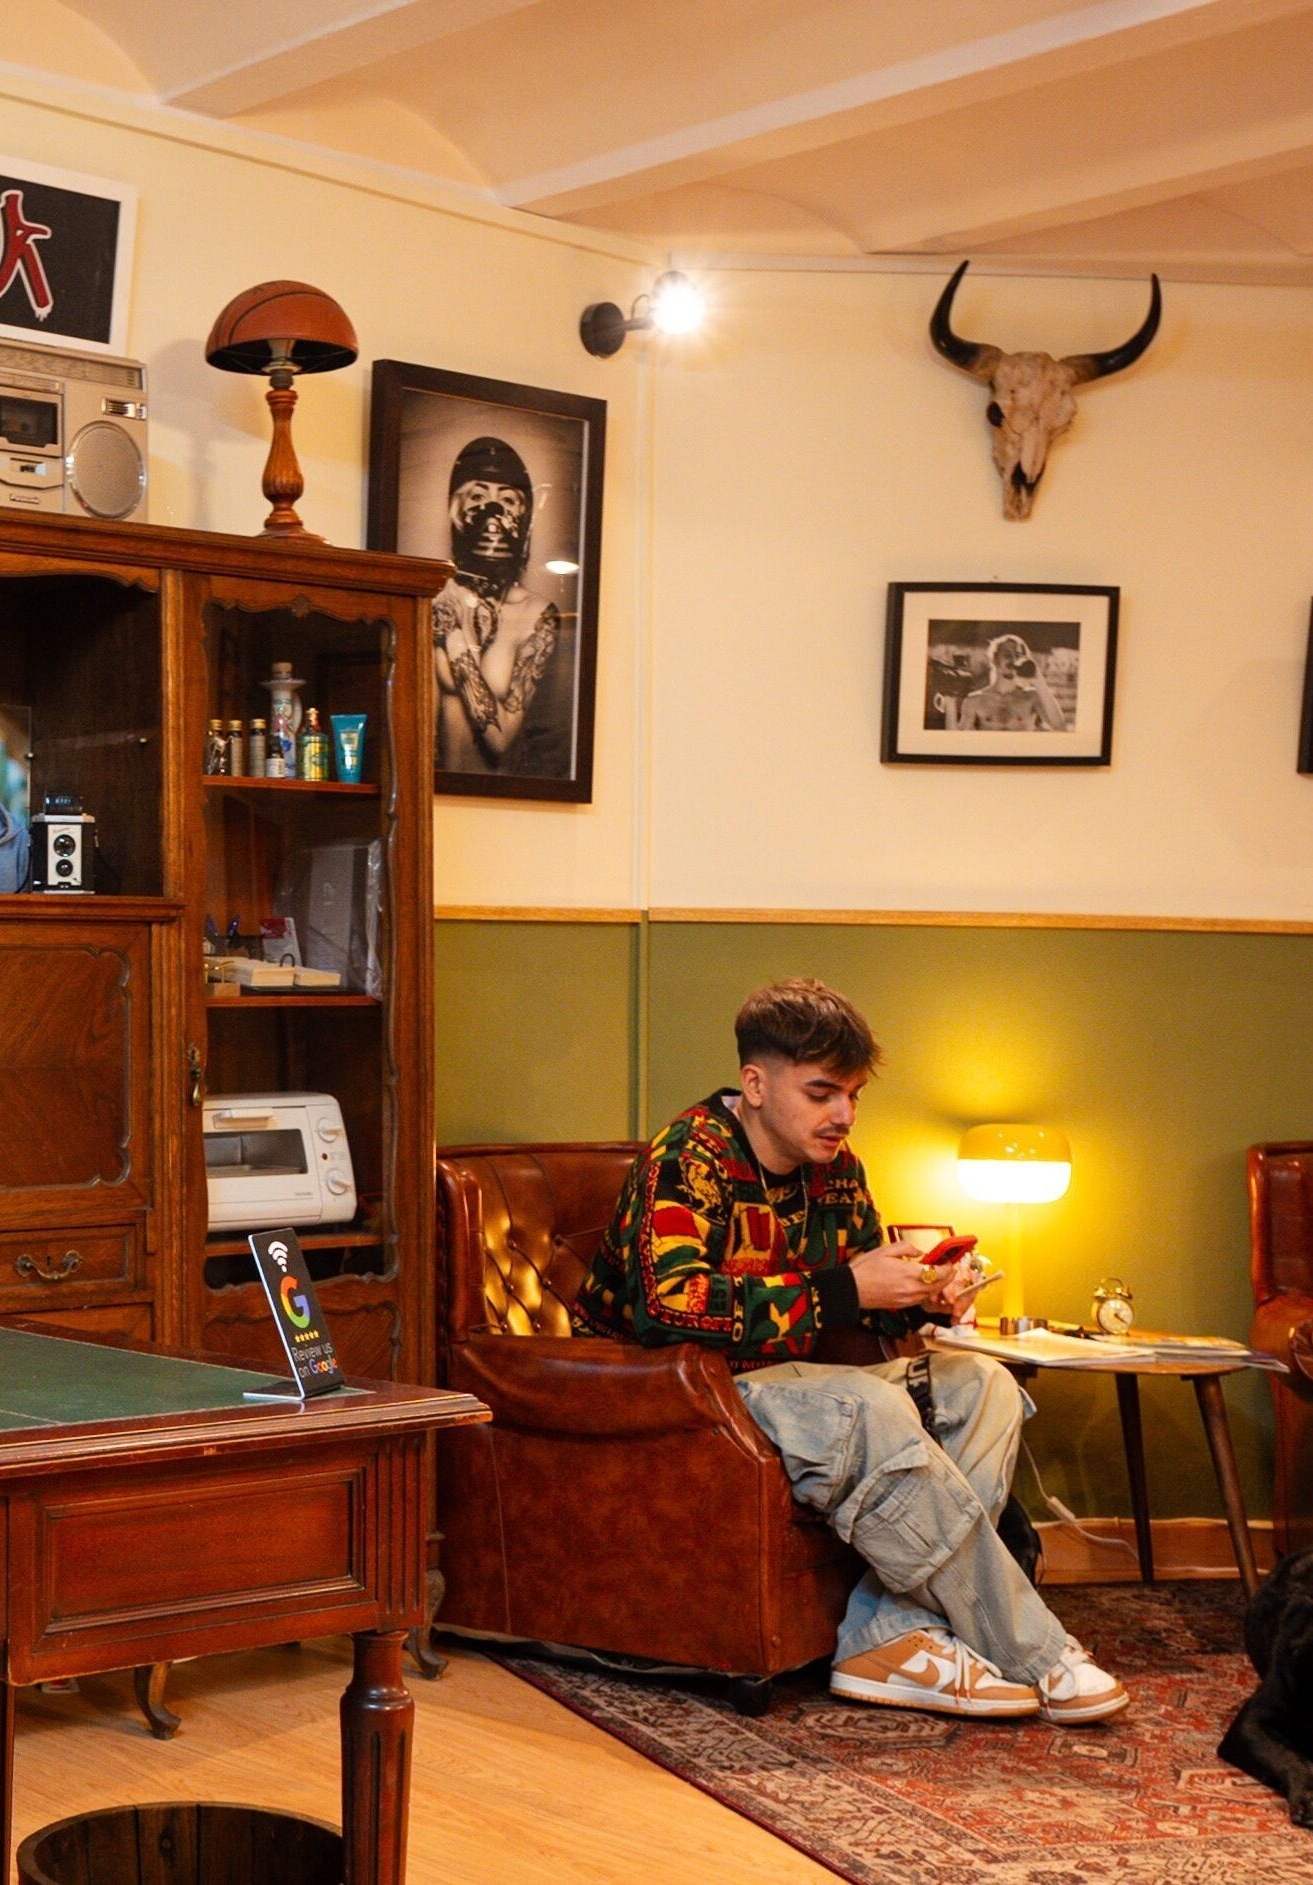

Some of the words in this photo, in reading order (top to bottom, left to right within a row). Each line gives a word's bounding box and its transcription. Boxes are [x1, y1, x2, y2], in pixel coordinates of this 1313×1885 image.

[291, 1344, 322, 1361] Review
[321, 1342, 333, 1354] us
[298, 1366, 311, 1378] on
[309, 1355, 339, 1375] Google
